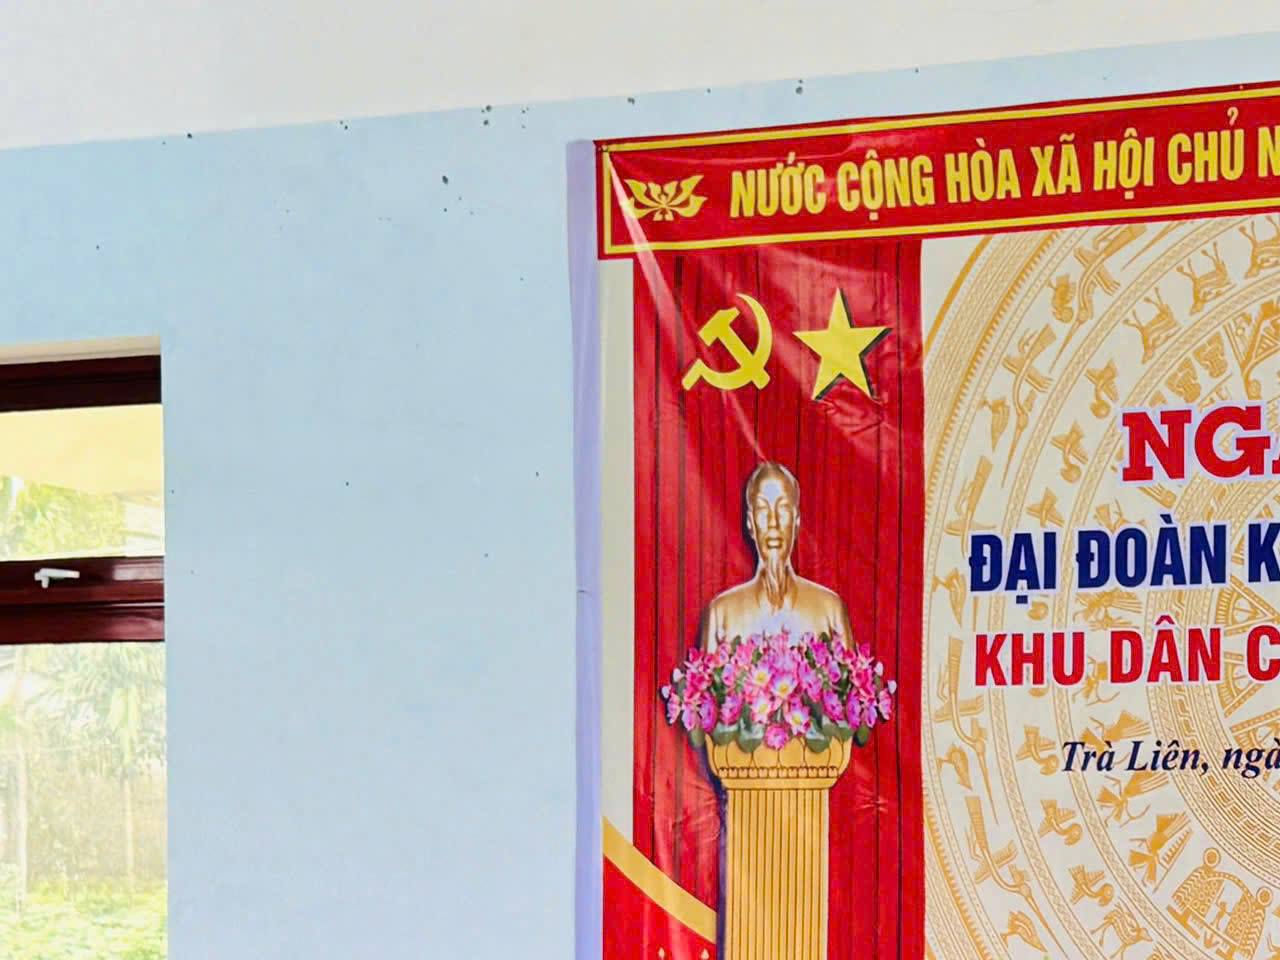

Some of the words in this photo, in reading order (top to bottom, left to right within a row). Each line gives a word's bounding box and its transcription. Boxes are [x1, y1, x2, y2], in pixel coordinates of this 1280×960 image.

[730, 151, 827, 218] NƯỚC
[837, 150, 935, 224] CỘNG
[945, 138, 1021, 203] HÒA
[1031, 134, 1082, 197] XÃ
[1093, 127, 1155, 200] HỘI
[1167, 106, 1246, 185] CHỦ
[968, 531, 1057, 604] ĐẠI
[1075, 513, 1227, 589] ĐOÀN
[975, 632, 1085, 687] KHU
[1110, 615, 1221, 684] DÂN
[1062, 740, 1115, 772] Trà
[1125, 739, 1210, 776] Liên,
